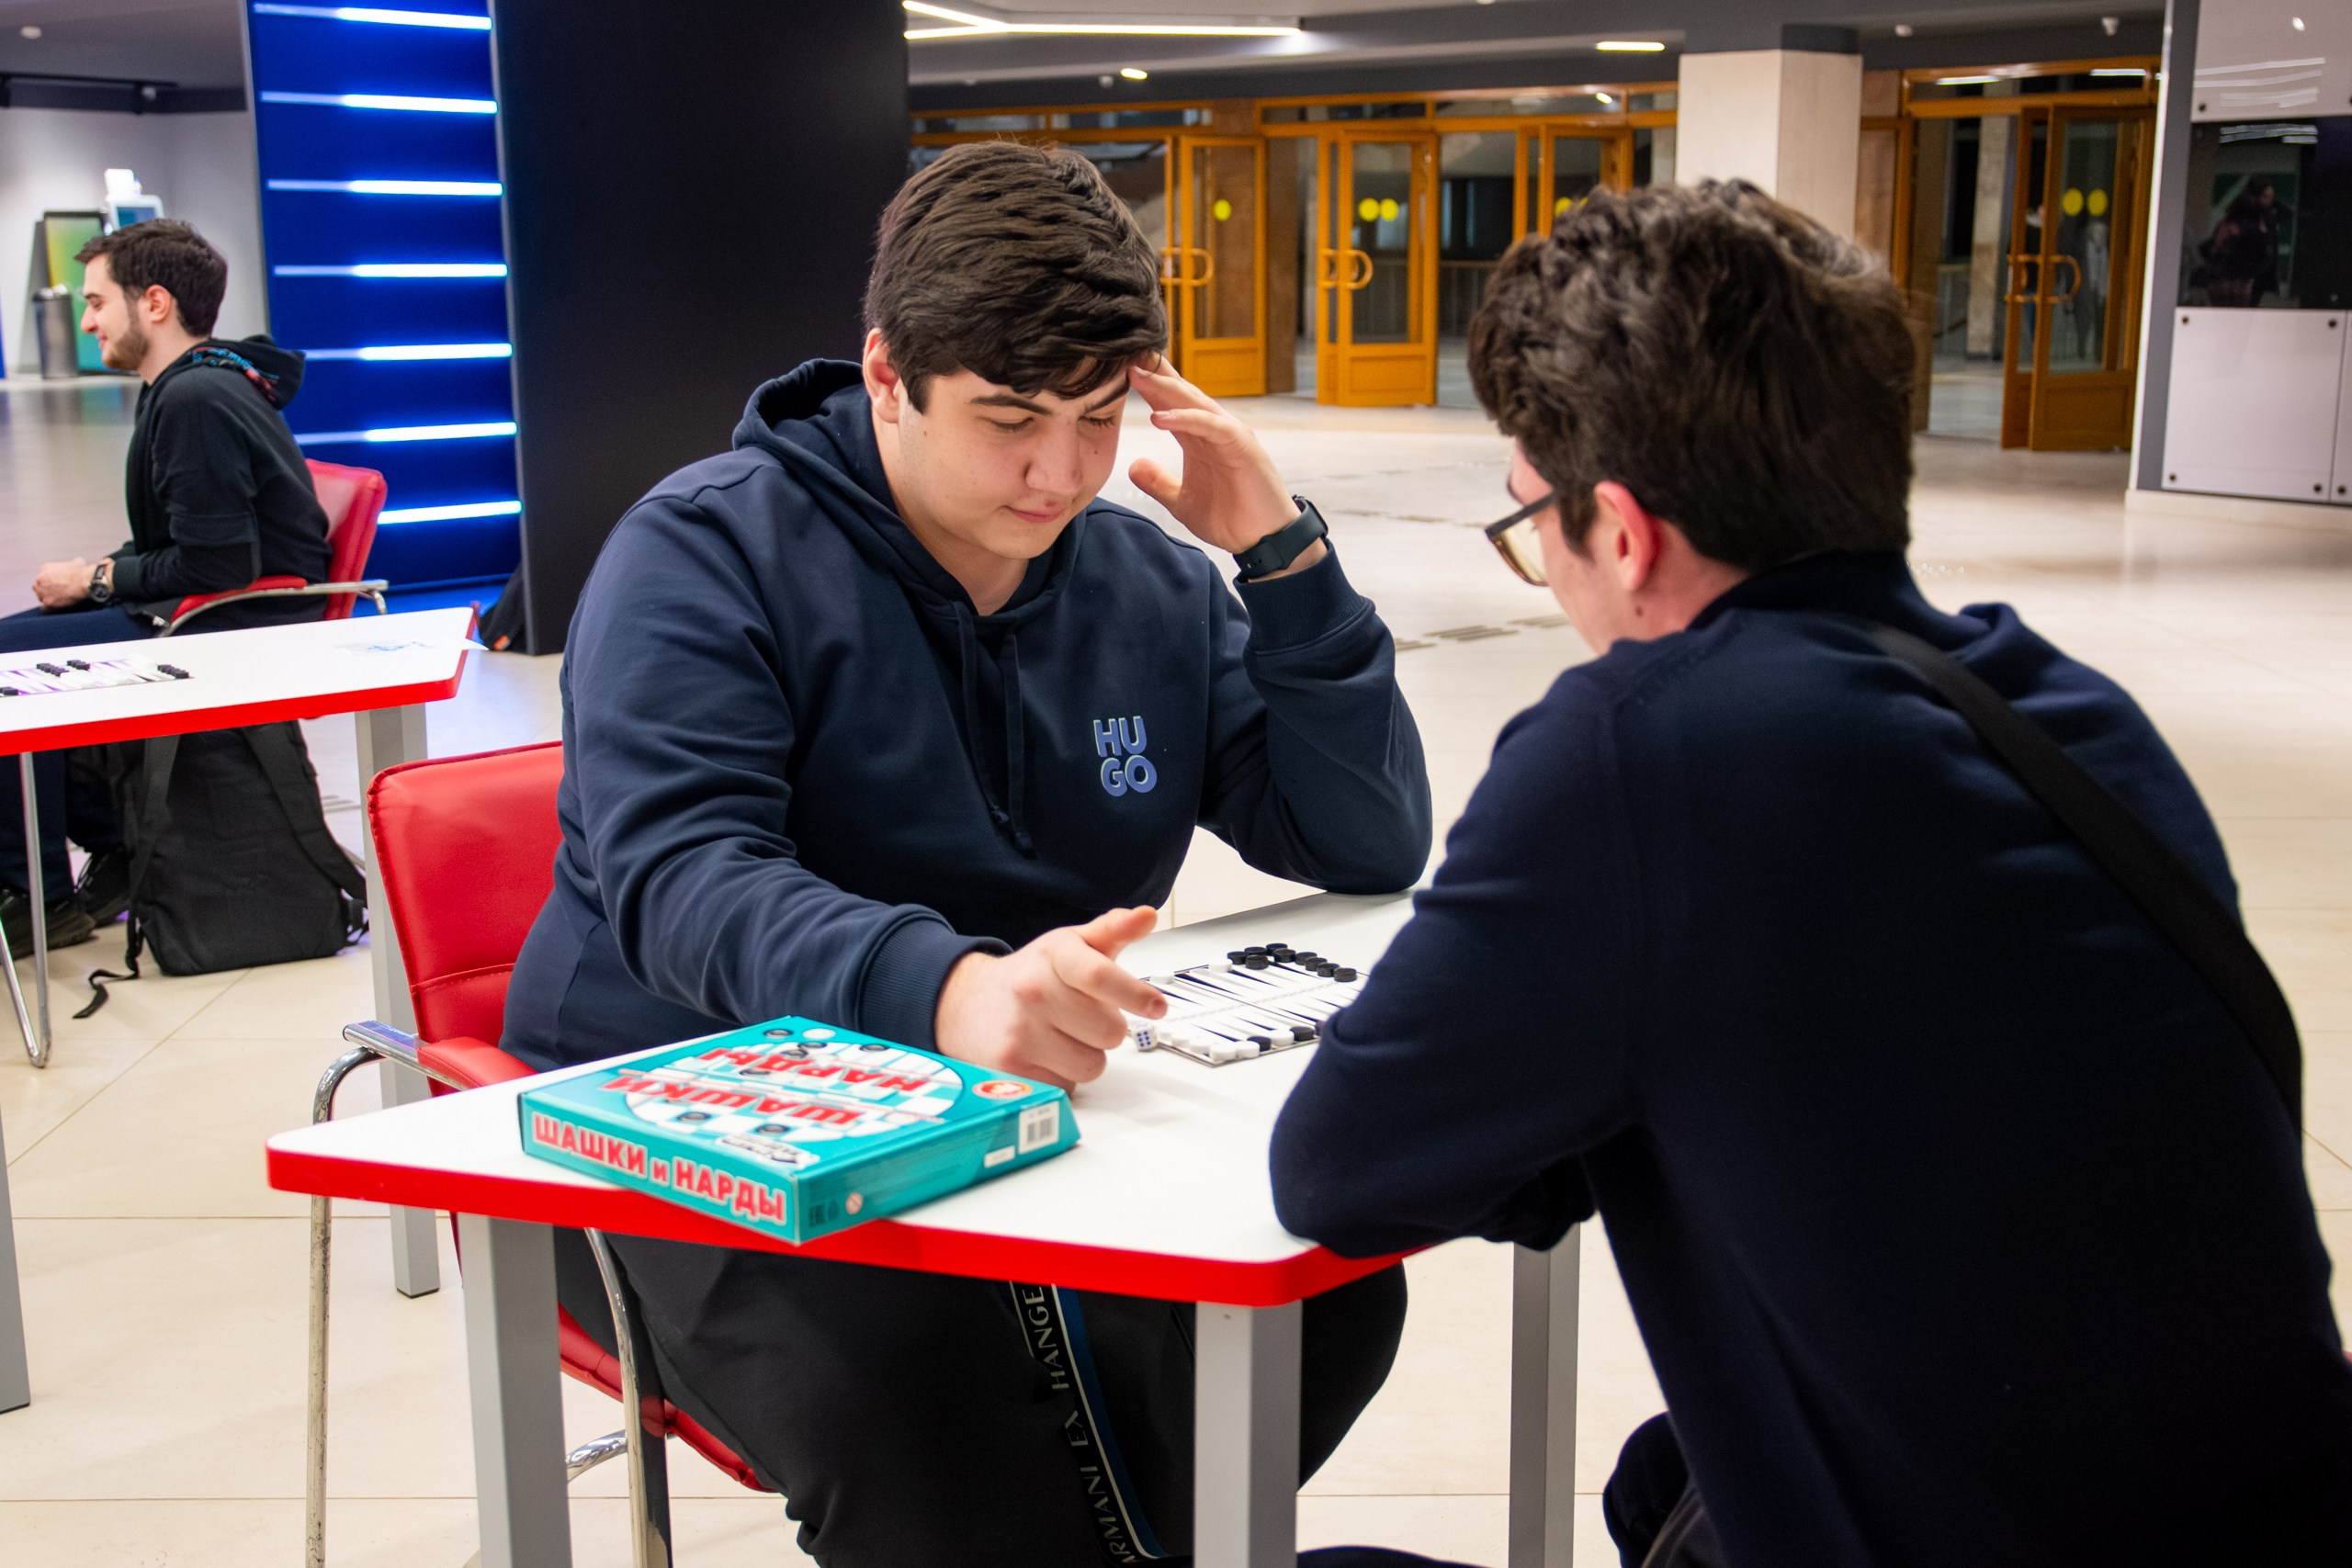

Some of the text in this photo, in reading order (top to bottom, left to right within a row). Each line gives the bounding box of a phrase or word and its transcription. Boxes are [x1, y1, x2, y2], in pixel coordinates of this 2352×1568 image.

[601, 1076, 864, 1124] ШАШКИ
[698, 1047, 931, 1091] НАРДЫ
[533, 1112, 647, 1177] ШАШКИ
[650, 1158, 668, 1183] и
[674, 1157, 786, 1222] НАРДЫ
[1022, 1286, 1090, 1448] EXHANGE
